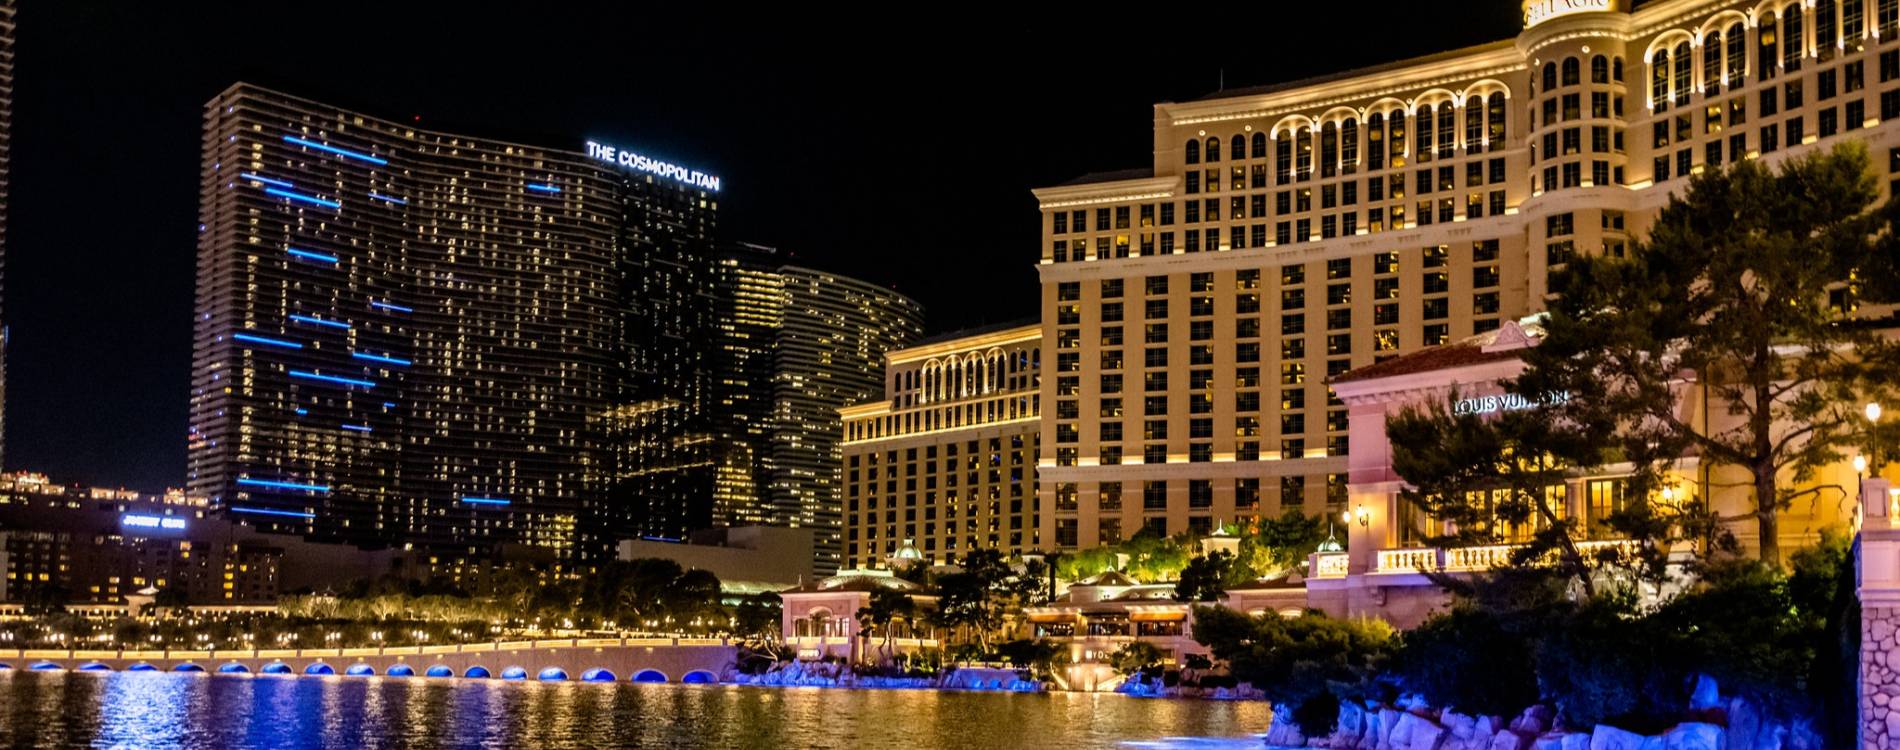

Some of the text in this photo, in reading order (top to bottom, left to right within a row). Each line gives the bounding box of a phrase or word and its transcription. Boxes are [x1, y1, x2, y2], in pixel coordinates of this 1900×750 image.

[586, 140, 720, 191] THE COSMOPOLITAN
[1455, 390, 1569, 415] LOUIS VUION
